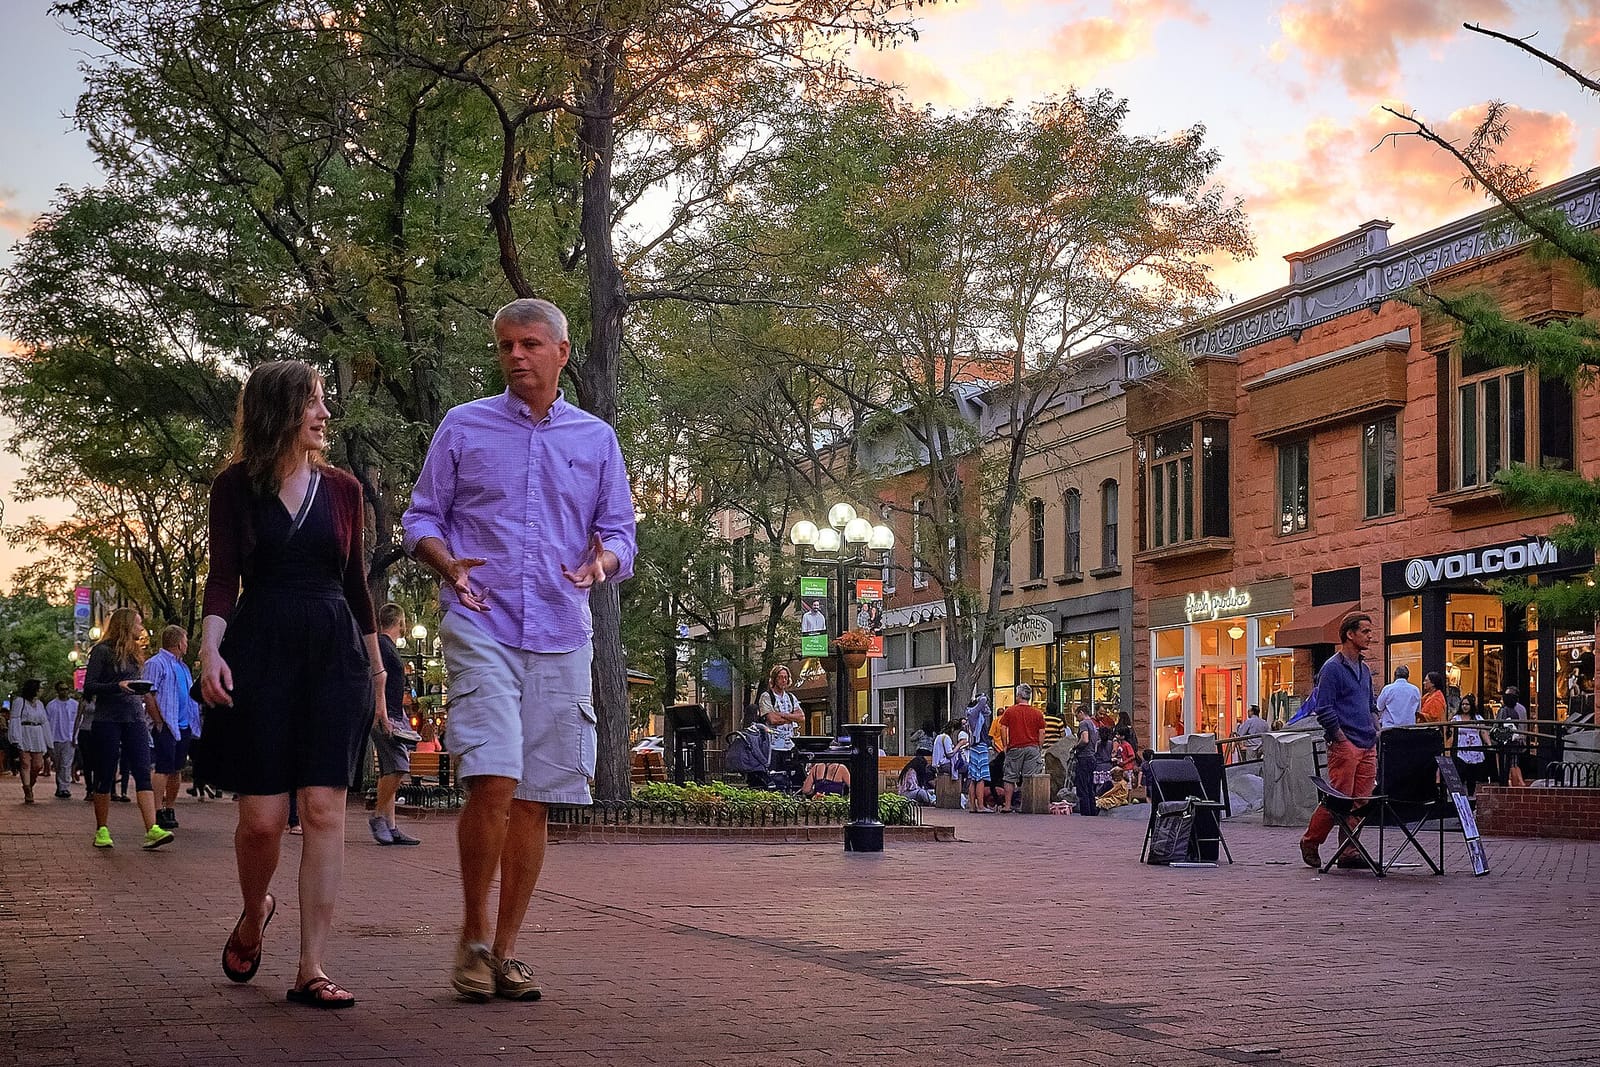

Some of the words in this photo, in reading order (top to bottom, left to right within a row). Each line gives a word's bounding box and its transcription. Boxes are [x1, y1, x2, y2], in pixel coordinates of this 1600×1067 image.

[1422, 541, 1558, 582] VOLCOM
[1184, 590, 1211, 622] fresh
[1210, 587, 1252, 620] produce
[1010, 618, 1048, 638] NATURE'S
[1020, 631, 1038, 643] OWN
